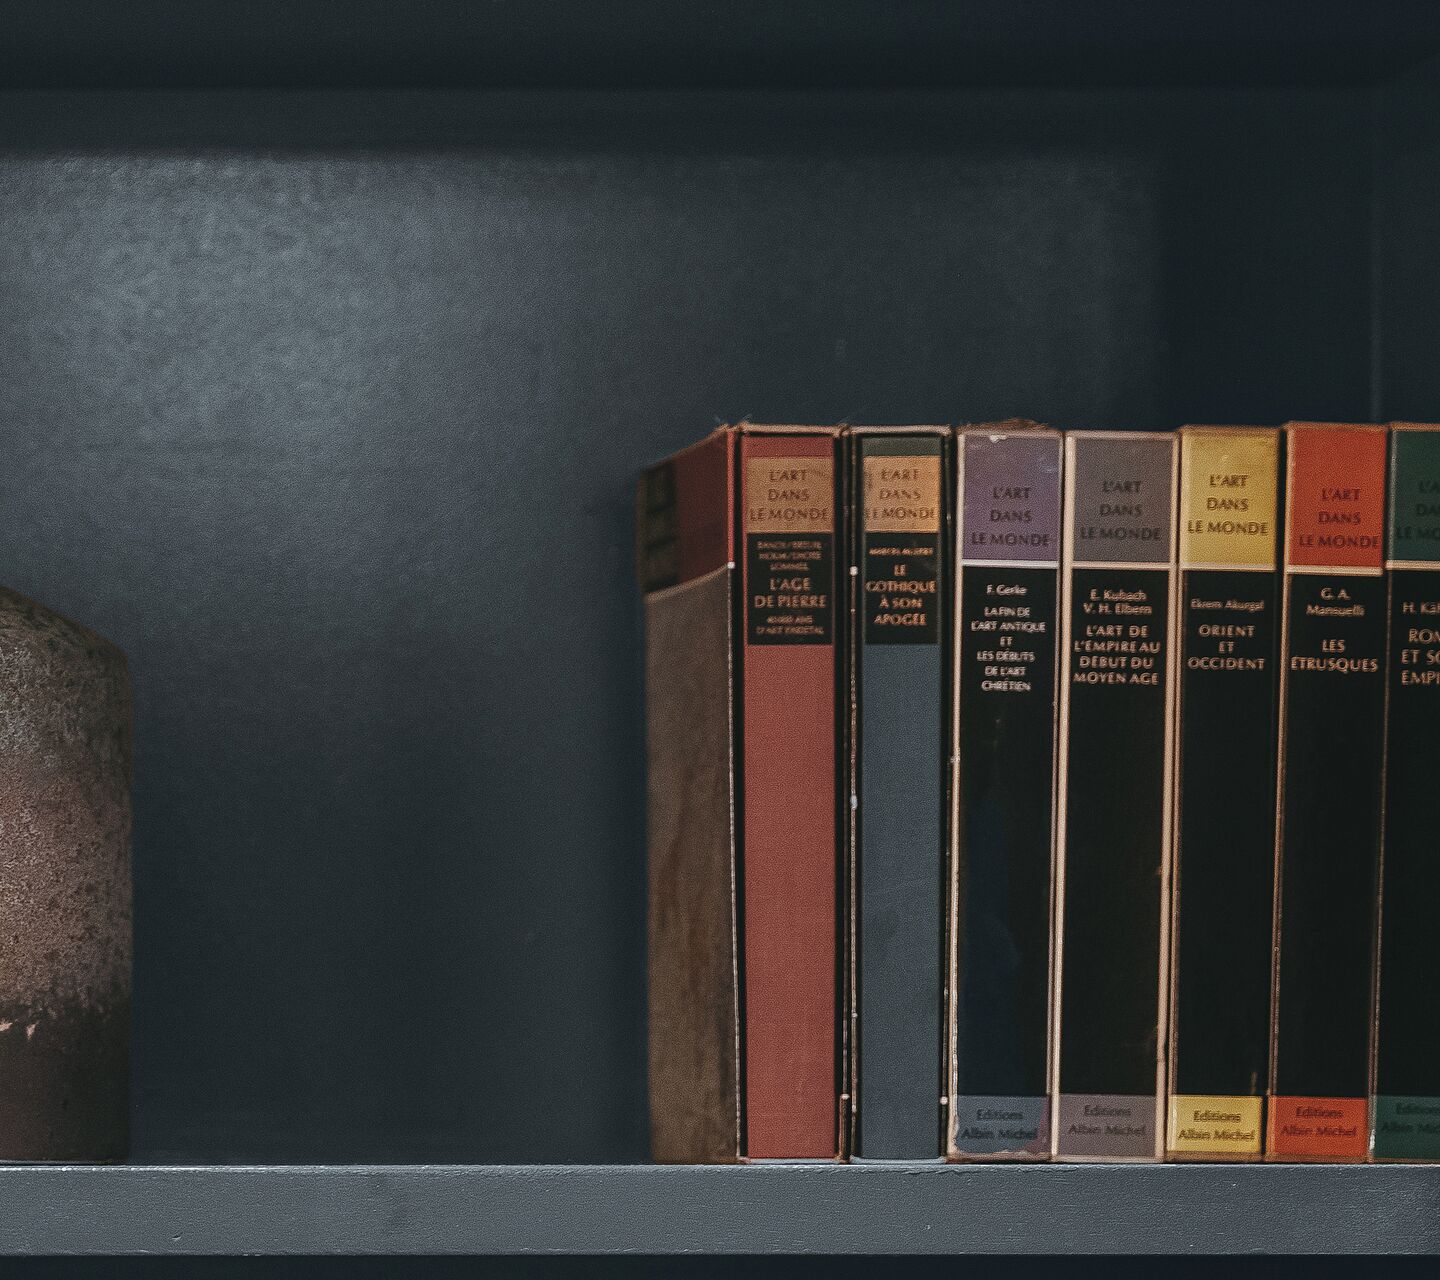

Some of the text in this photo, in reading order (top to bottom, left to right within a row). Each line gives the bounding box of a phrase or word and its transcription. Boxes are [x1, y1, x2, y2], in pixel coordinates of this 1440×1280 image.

[1207, 498, 1248, 511] DANS
[1188, 520, 1268, 535] LE MONDE
[866, 580, 937, 594] GOTHIQUE
[777, 594, 826, 608] PIERRE
[1129, 625, 1148, 637] DE
[1199, 624, 1255, 638] ORIENT
[1074, 641, 1160, 653] L'EMPIRE AU
[1218, 641, 1235, 653] ET
[1322, 639, 1346, 653] LES
[1131, 656, 1154, 668] DU
[1187, 657, 1265, 670] OCCIDENT
[1073, 672, 1158, 685] MOYEN AGE
